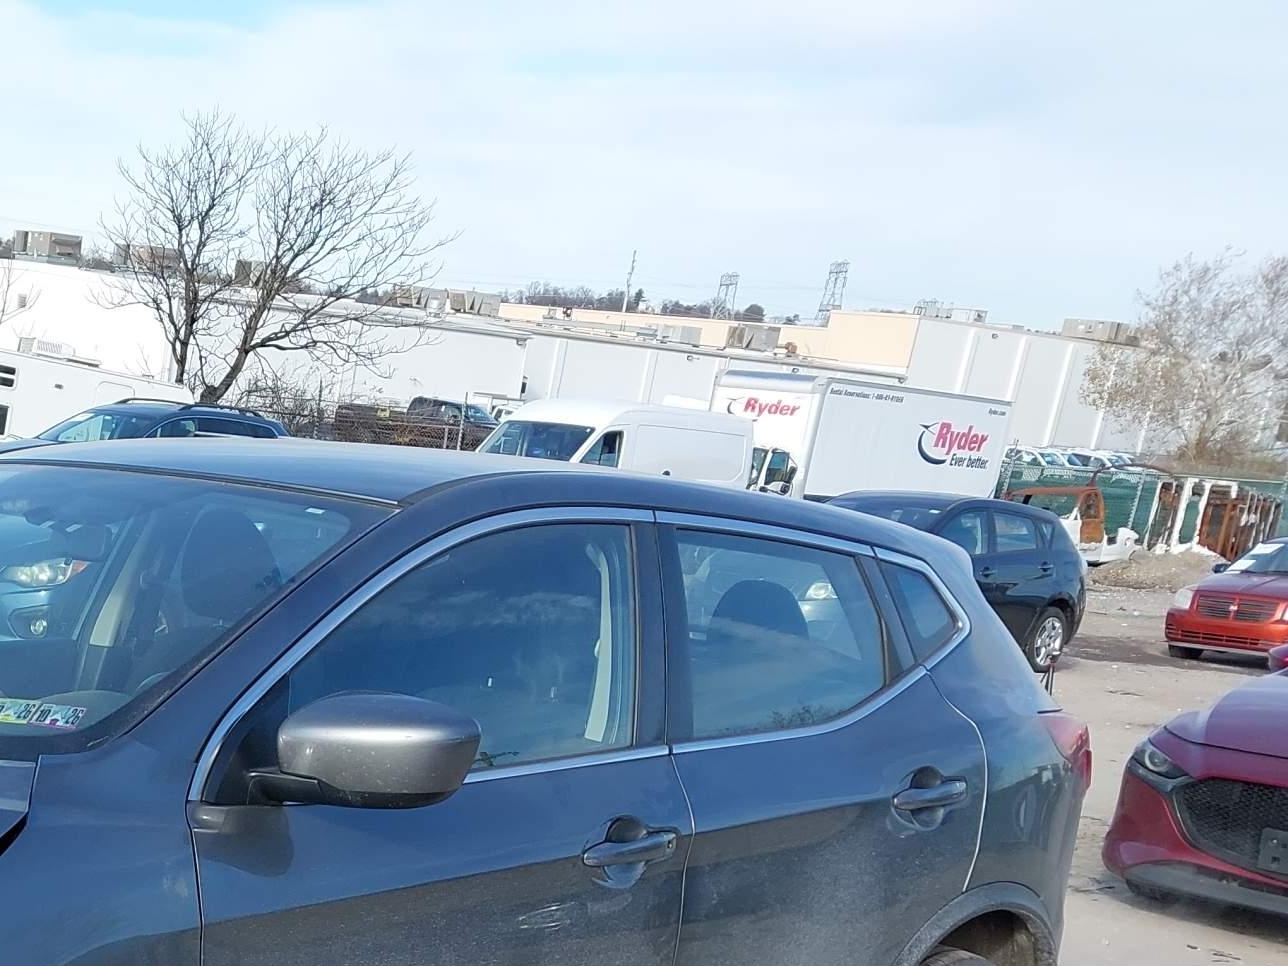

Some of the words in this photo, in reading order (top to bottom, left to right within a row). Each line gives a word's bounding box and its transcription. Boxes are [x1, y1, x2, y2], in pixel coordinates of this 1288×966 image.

[743, 397, 801, 417] Ryder
[933, 421, 990, 456] Ryder
[949, 453, 968, 467] Ever
[16, 703, 36, 720] 26
[36, 708, 52, 722] 10
[66, 708, 85, 726] 26
